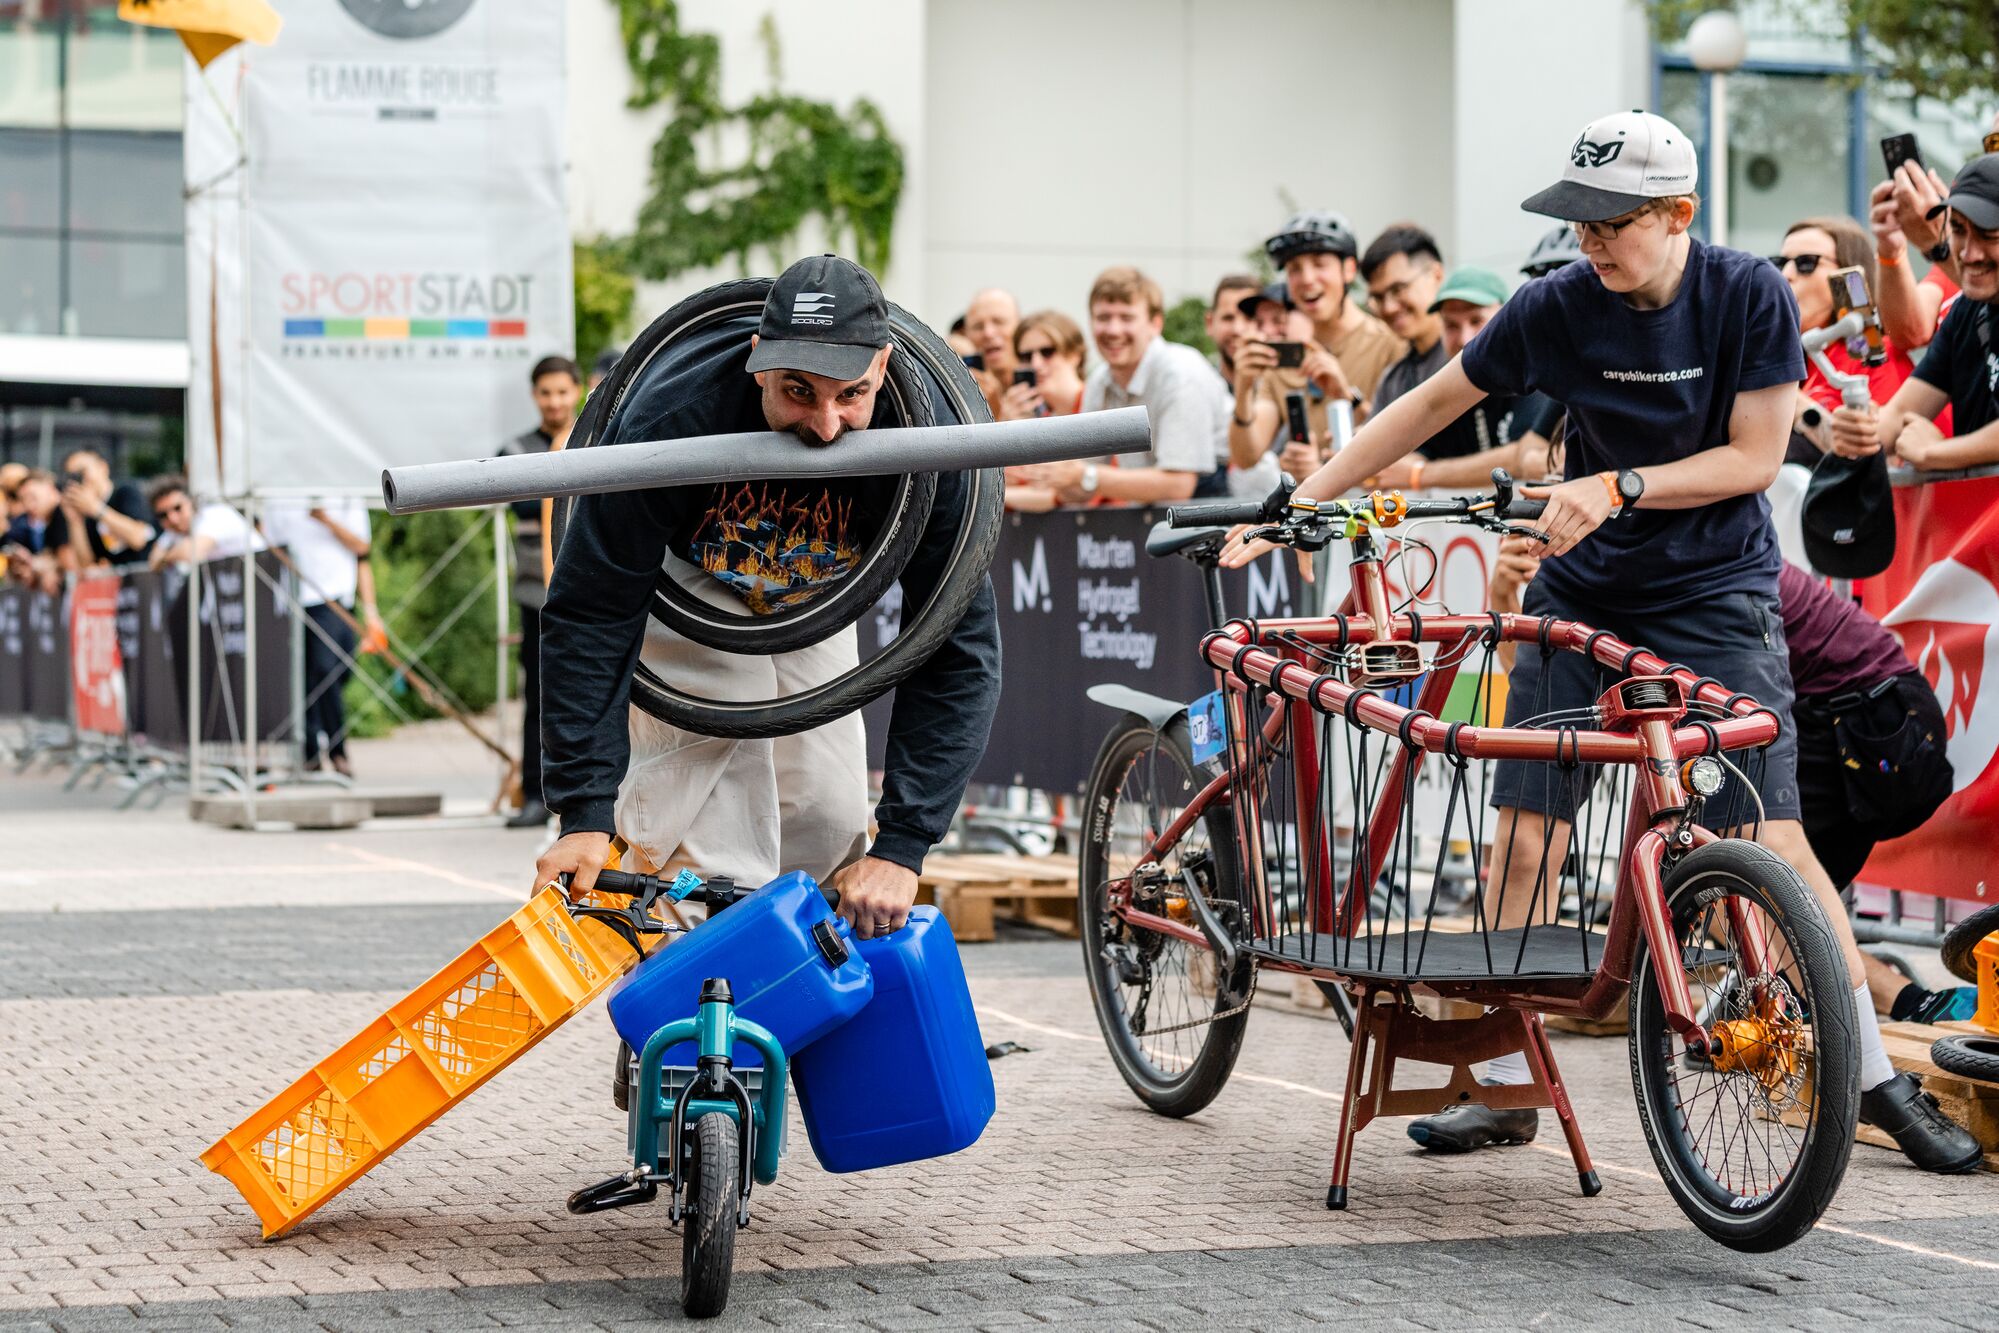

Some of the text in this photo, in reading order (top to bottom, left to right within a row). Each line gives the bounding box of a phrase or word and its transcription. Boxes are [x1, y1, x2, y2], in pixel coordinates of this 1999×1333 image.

[308, 64, 410, 103] FLAMME
[281, 272, 534, 315] SPORTSTADT
[1603, 366, 1703, 383] cargobikerace.com
[1076, 533, 1136, 568] Maurten
[1077, 577, 1140, 622] Hydrogel
[1077, 622, 1157, 669] Technology
[1629, 1034, 1654, 1142] CONTINENTAL
